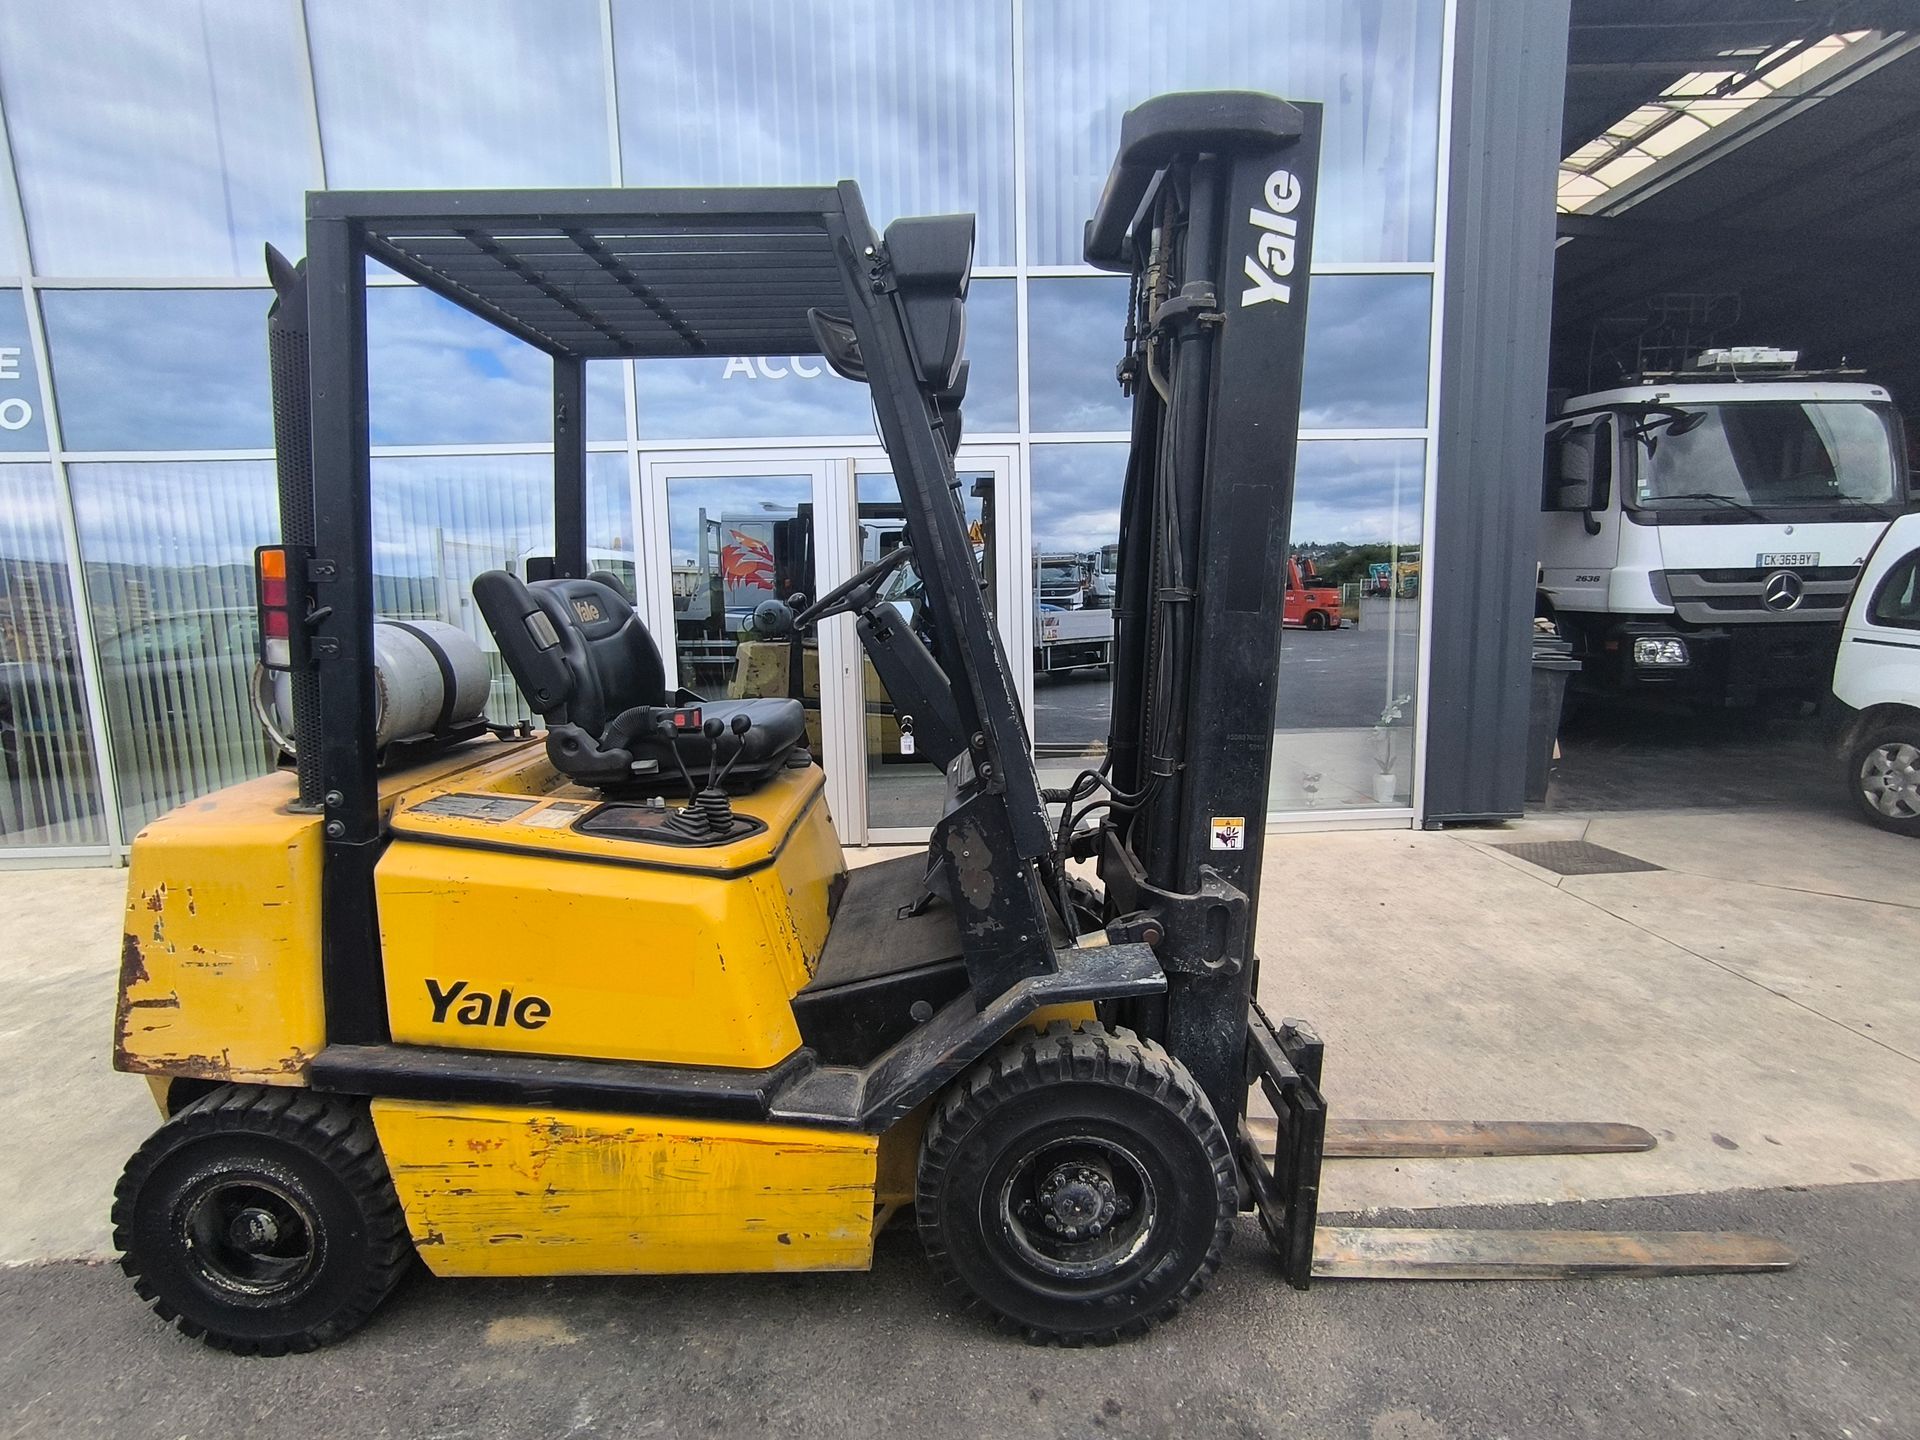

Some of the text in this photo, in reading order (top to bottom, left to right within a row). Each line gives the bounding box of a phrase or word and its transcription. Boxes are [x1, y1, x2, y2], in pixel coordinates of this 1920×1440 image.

[1241, 169, 1301, 308] Yale
[722, 356, 844, 379] ACC
[1575, 575, 1601, 583] 2636
[572, 601, 600, 623] Yale
[424, 978, 551, 1030] Yale
